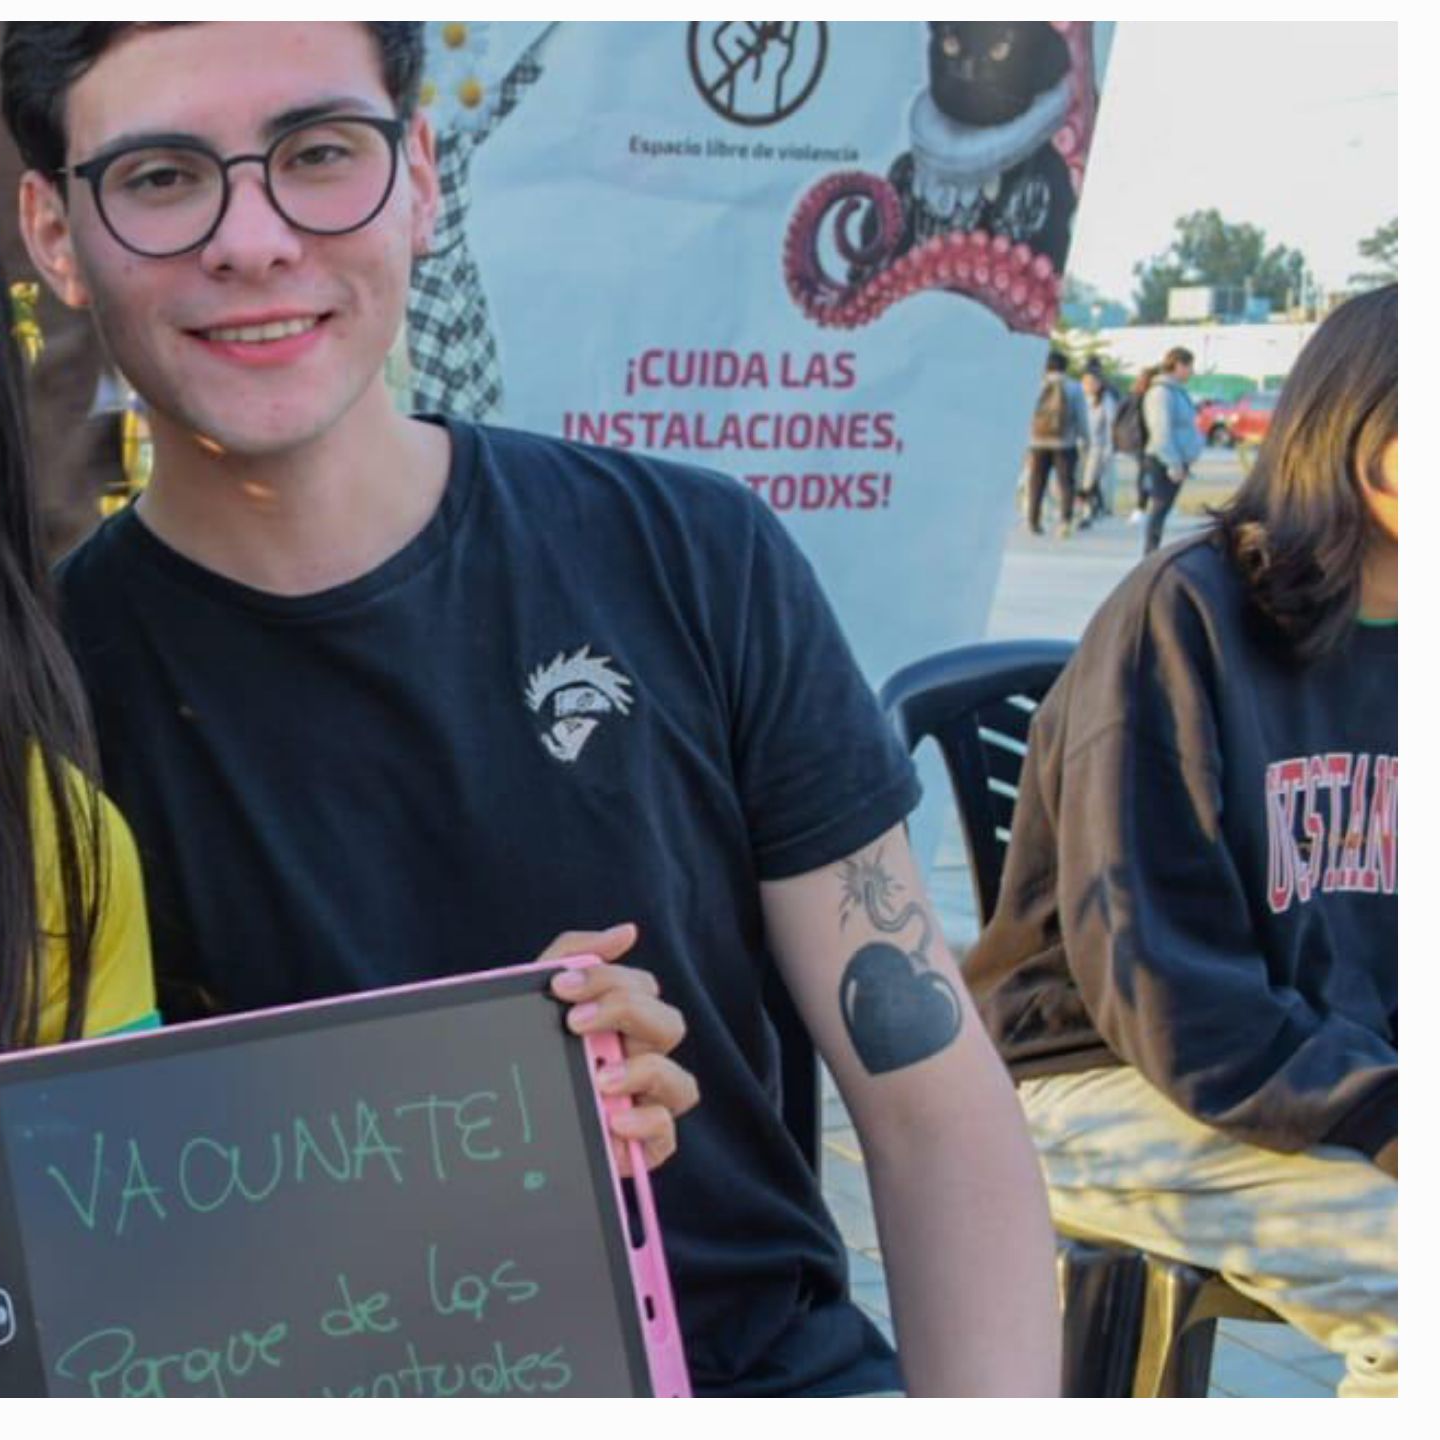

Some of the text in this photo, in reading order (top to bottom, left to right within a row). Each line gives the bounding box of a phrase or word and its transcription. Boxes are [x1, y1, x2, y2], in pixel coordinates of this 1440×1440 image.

[628, 135, 859, 162] Espacio libre de violencia
[625, 349, 856, 396] ¡CUIDA LAS
[562, 412, 903, 454] INSTALACIONES,
[744, 473, 892, 511] TODXS!
[320, 1272, 399, 1337] de
